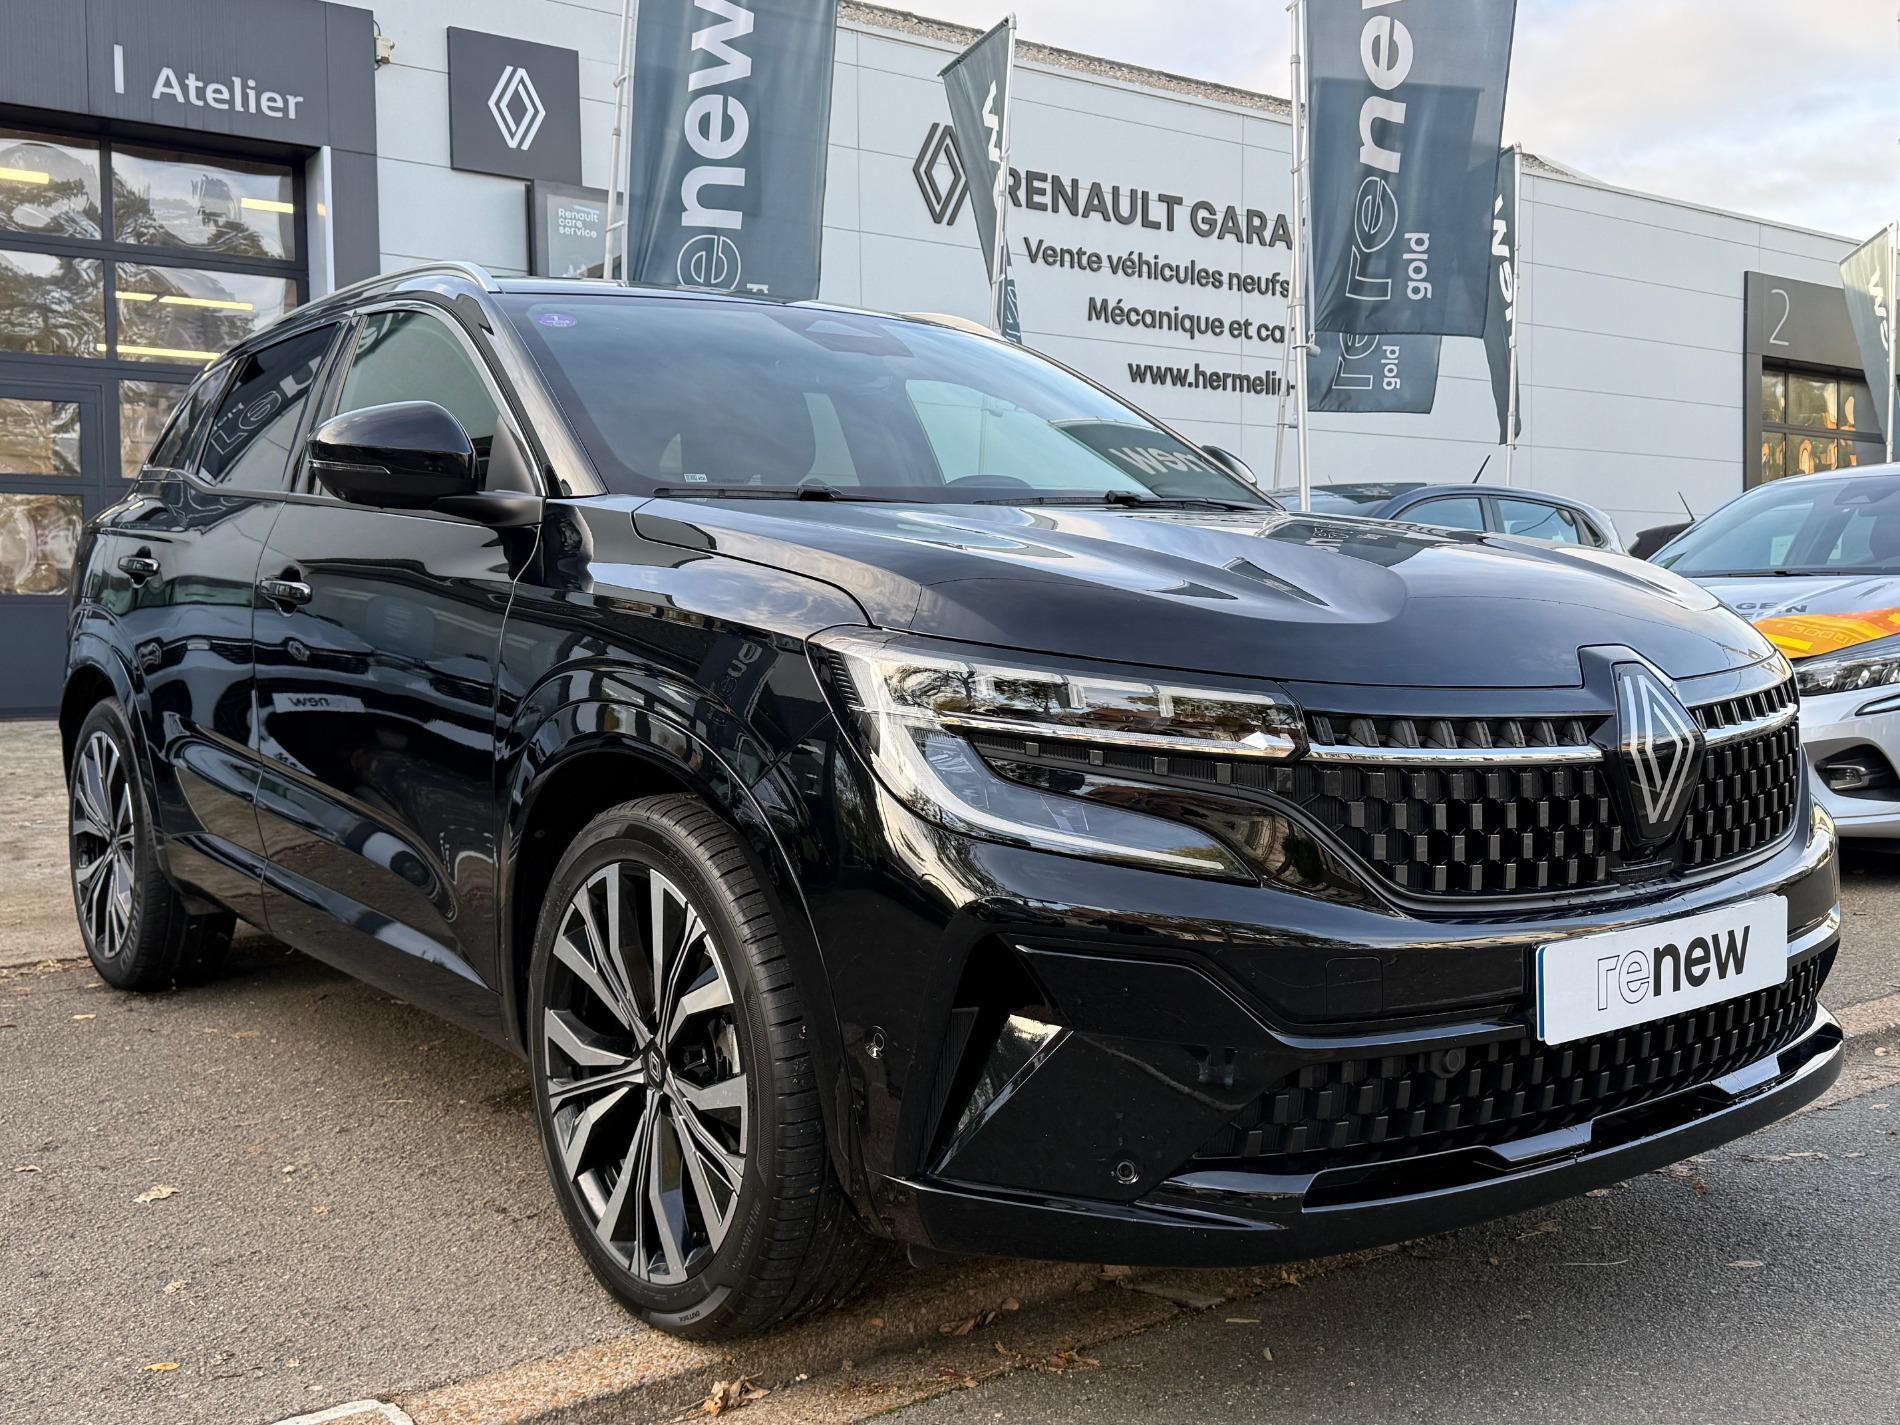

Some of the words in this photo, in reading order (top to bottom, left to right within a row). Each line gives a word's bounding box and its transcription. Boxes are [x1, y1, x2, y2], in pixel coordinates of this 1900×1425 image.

[152, 67, 304, 119] Atelier
[1346, 0, 1414, 300] rene
[558, 208, 599, 223] Renault
[559, 218, 583, 228] care
[559, 227, 597, 239] service
[1008, 167, 1183, 231] RENAULT
[1190, 201, 1293, 250] GARA
[1024, 237, 1103, 272] Vente
[1108, 251, 1224, 289] véhicules
[1228, 272, 1290, 298] neufs
[1403, 232, 1432, 300] gold
[1088, 297, 1225, 340] Mécanique
[1229, 318, 1253, 340] et
[1257, 324, 1295, 343] ca
[1769, 289, 1790, 345] 2
[1382, 345, 1400, 390] gold
[1597, 925, 1750, 1011] renew
